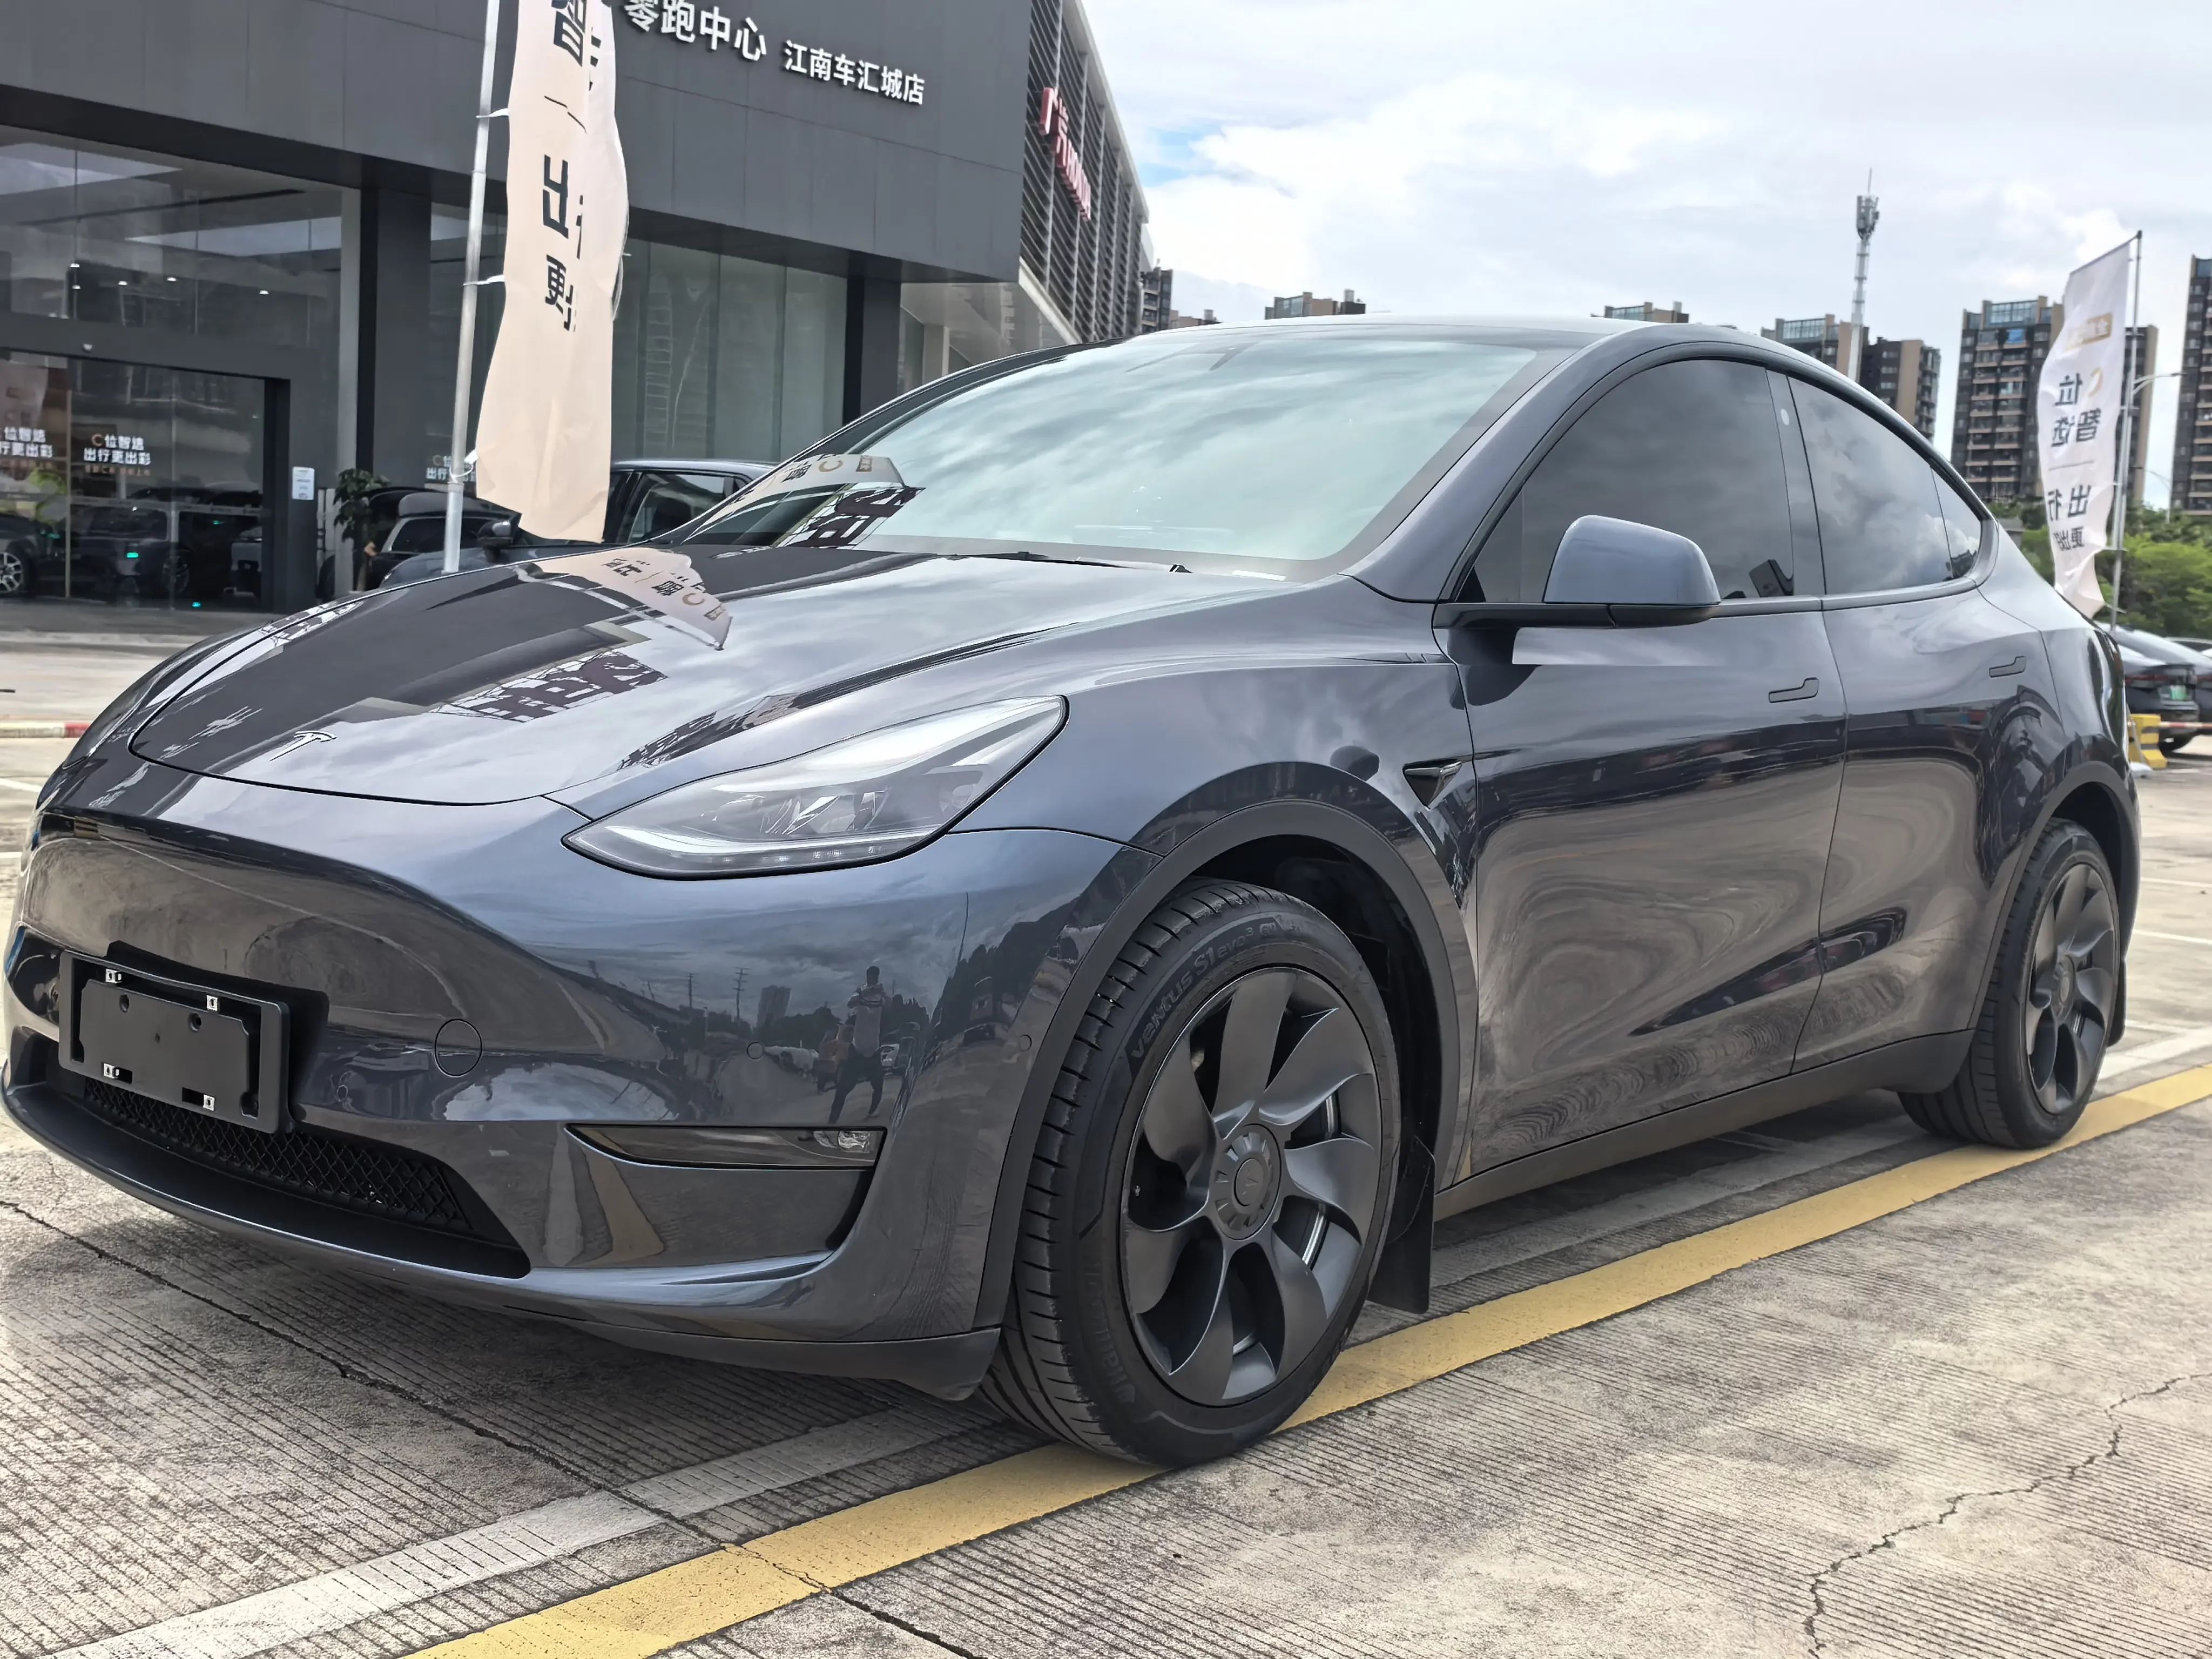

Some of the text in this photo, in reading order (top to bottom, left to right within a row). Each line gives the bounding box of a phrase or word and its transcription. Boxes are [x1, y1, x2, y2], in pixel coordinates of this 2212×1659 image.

[624, 0, 925, 105] 零跑中心 江南车汇城店
